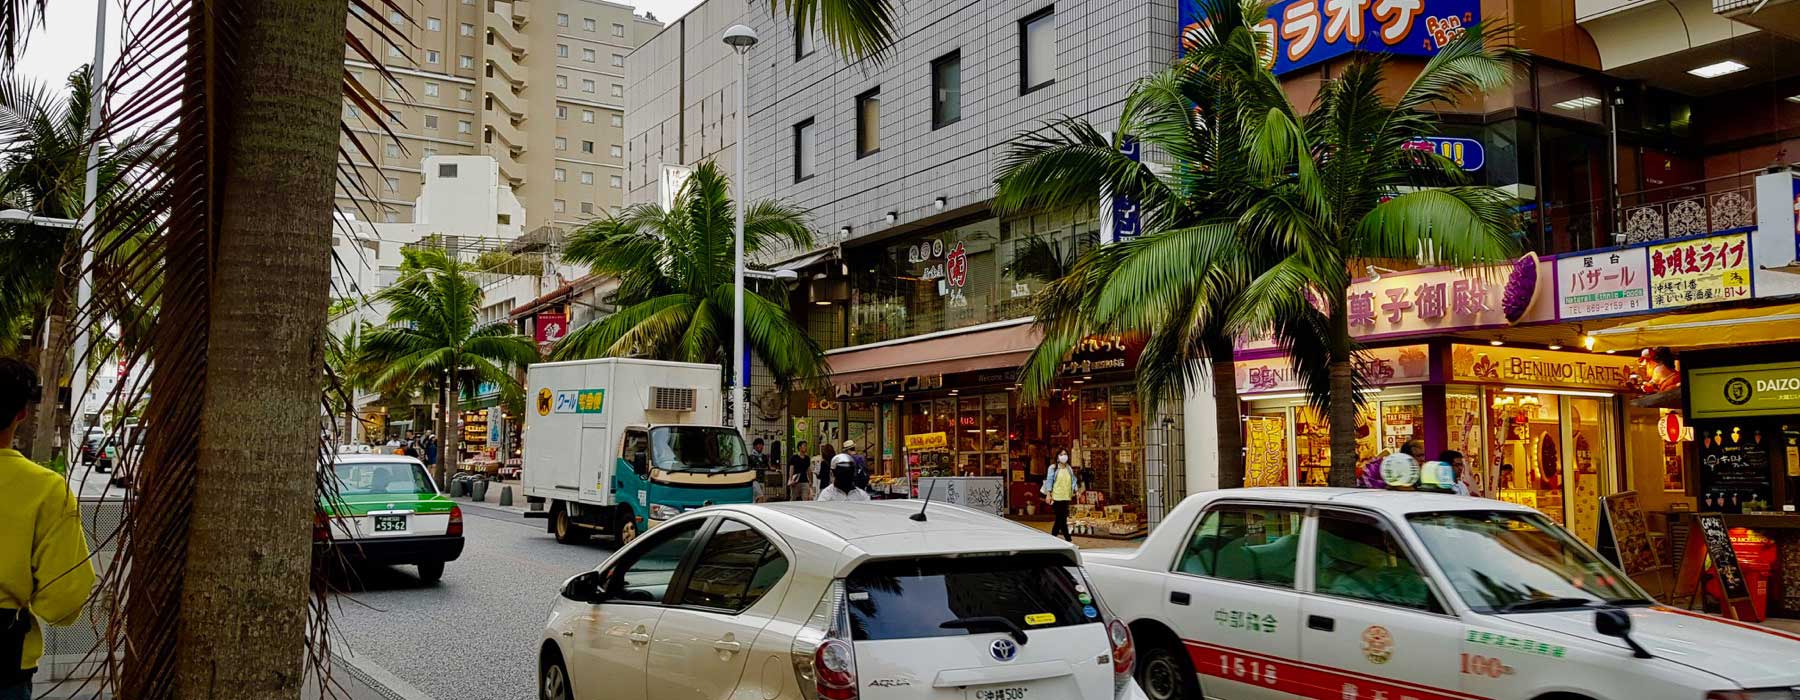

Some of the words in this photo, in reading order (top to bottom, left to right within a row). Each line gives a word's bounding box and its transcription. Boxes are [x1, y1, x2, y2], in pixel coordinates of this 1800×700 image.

[1426, 16, 1460, 35] Ban
[1652, 239, 1745, 278] 島唄生ライブ
[1571, 266, 1636, 293] バザール
[1569, 306, 1582, 314] TEL
[1510, 357, 1573, 379] BENIIMO
[1576, 361, 1620, 381] TARTE
[1757, 377, 1800, 392] DAIZO
[867, 679, 911, 687] AQUA
